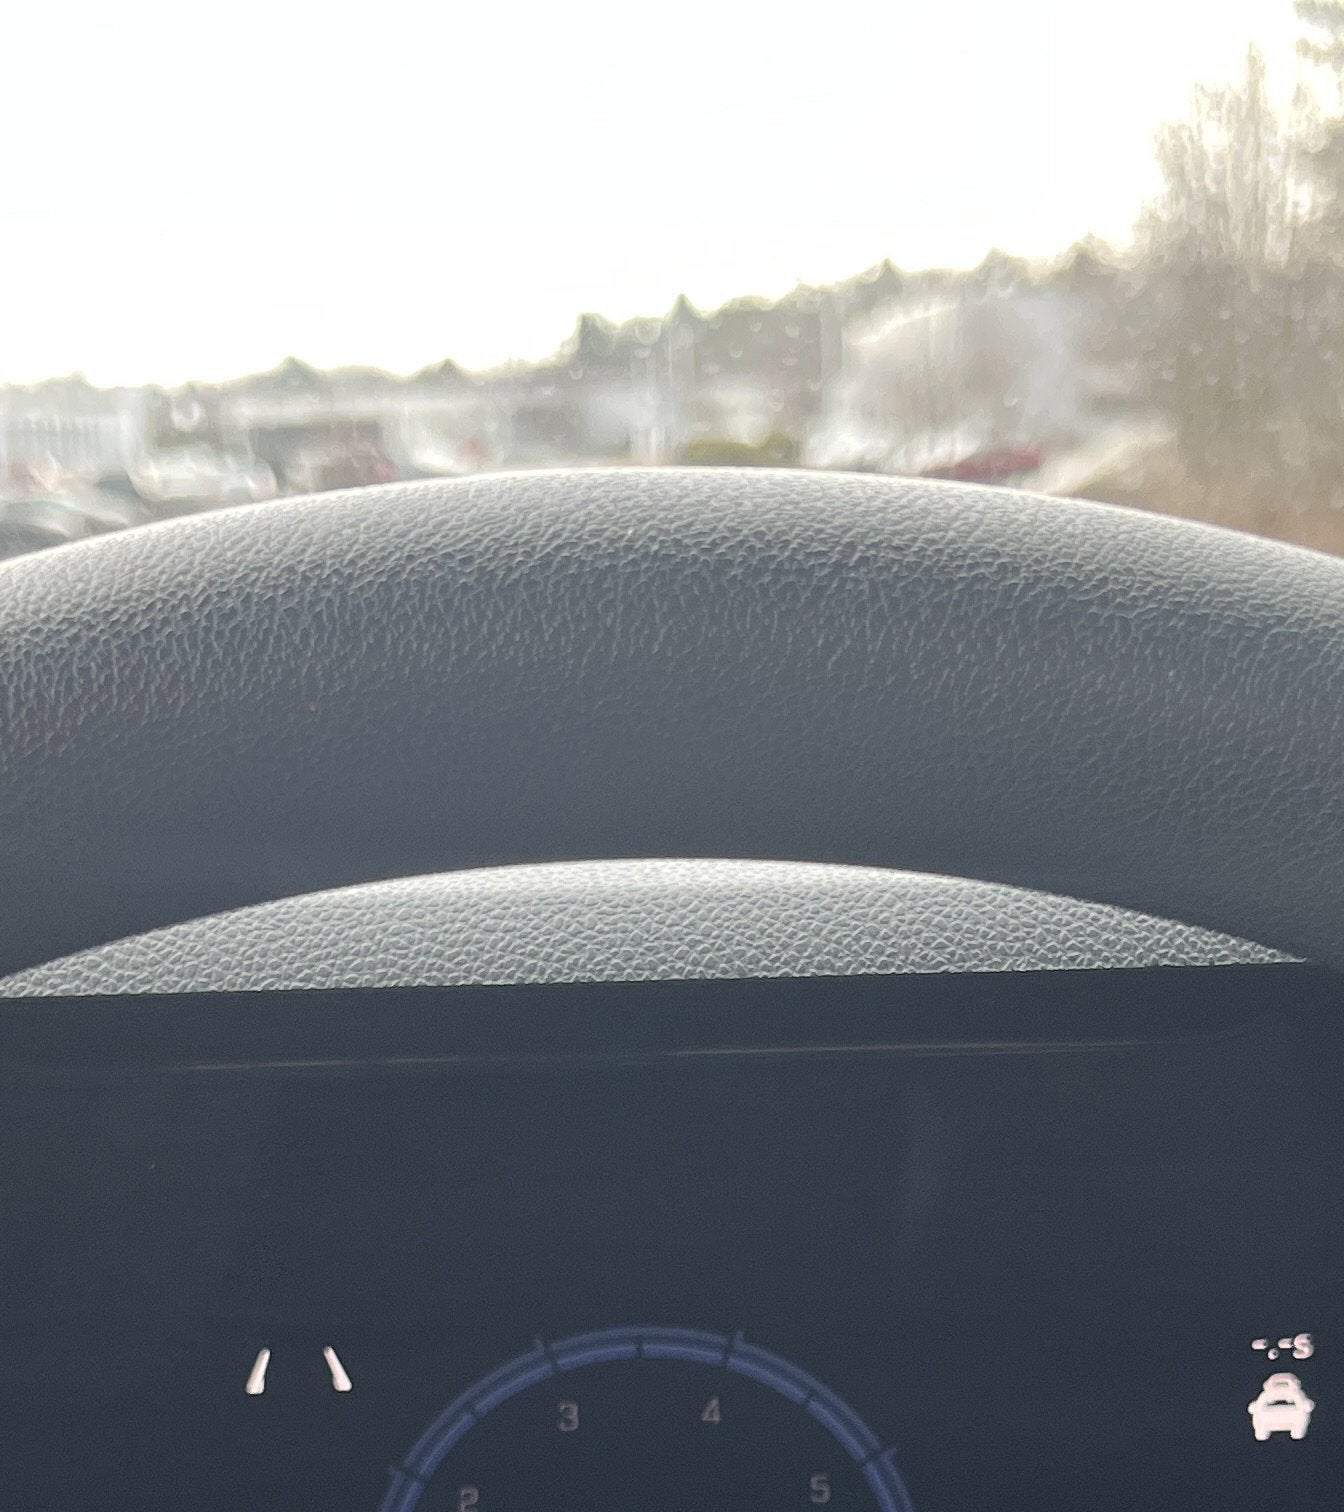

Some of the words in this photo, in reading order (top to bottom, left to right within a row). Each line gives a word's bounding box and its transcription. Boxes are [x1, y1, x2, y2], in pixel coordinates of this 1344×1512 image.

[558, 1402, 580, 1432] 3
[700, 1398, 722, 1425] 4
[809, 1474, 831, 1504] 5
